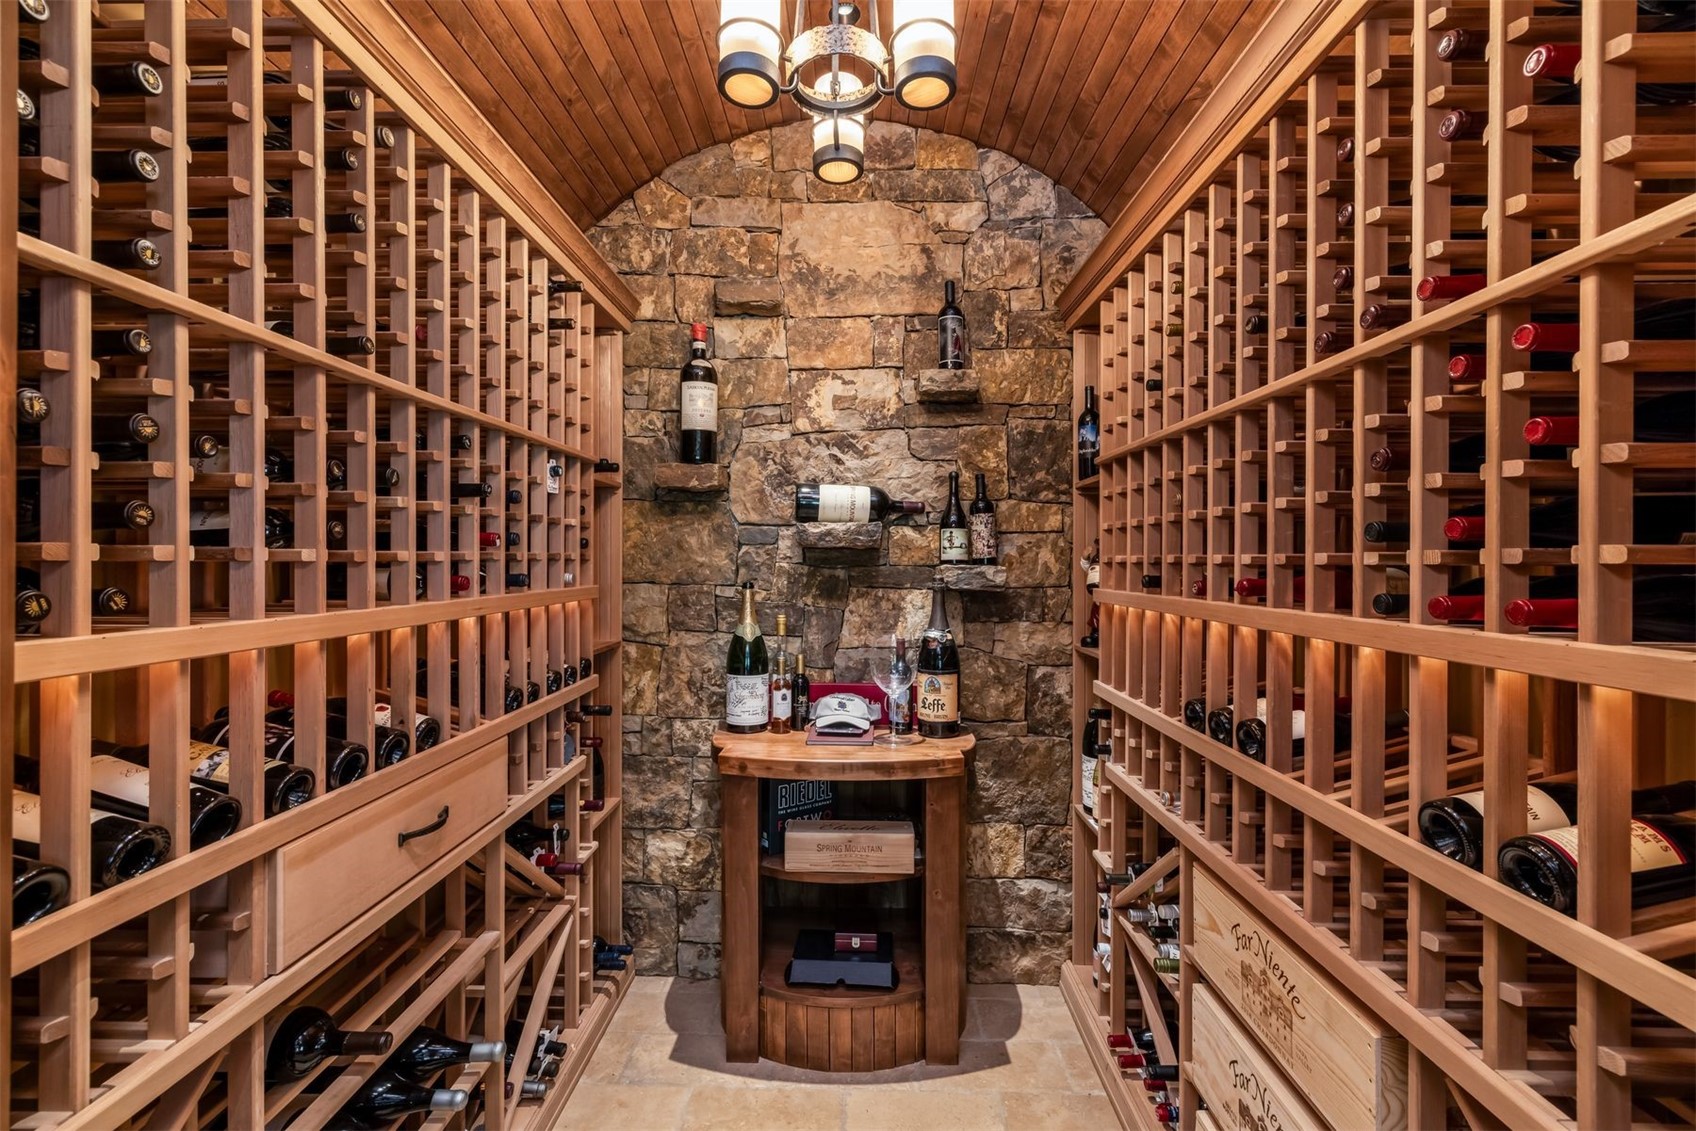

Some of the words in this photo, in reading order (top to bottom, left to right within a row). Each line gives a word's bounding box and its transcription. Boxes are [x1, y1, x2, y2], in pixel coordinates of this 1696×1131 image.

[921, 696, 946, 713] Leffe
[778, 780, 832, 808] RIEDEL
[812, 800, 832, 808] COMPANY
[816, 843, 843, 853] SPRING
[844, 844, 883, 853] MOUNTAIN
[1231, 923, 1253, 952] Far
[1252, 930, 1306, 1020] Niente
[1228, 1059, 1251, 1093] Far
